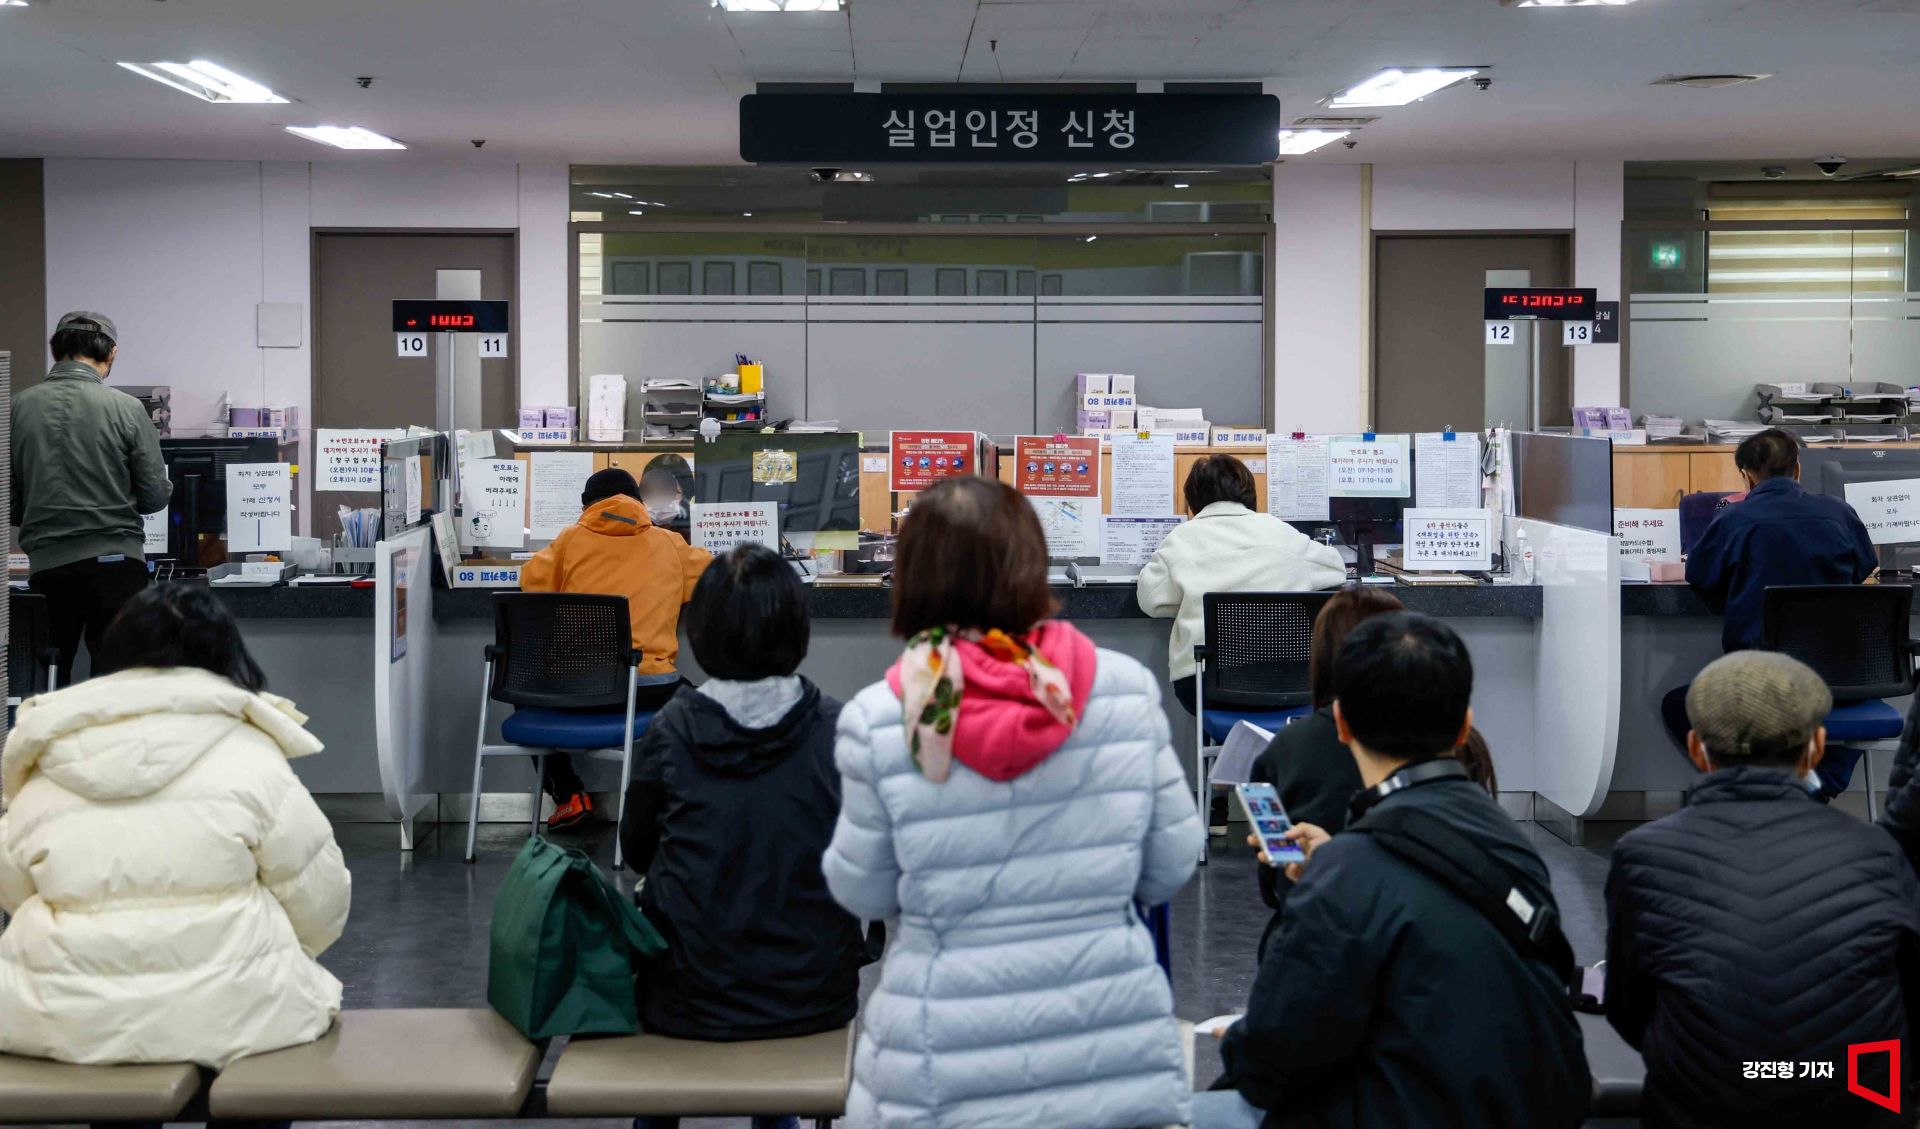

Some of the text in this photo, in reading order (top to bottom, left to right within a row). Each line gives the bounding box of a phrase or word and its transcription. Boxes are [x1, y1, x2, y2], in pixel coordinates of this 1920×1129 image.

[882, 109, 1136, 148] 실업인정 신청
[1491, 326, 1510, 339] 12
[1568, 326, 1588, 340] 13
[402, 338, 423, 351] 10
[484, 339, 500, 352] 11
[493, 464, 519, 472] 번호표는
[485, 487, 518, 495] 버려주세요
[1618, 519, 1664, 528] 준비해 주세요
[459, 571, 518, 581] 한솔카피 80
